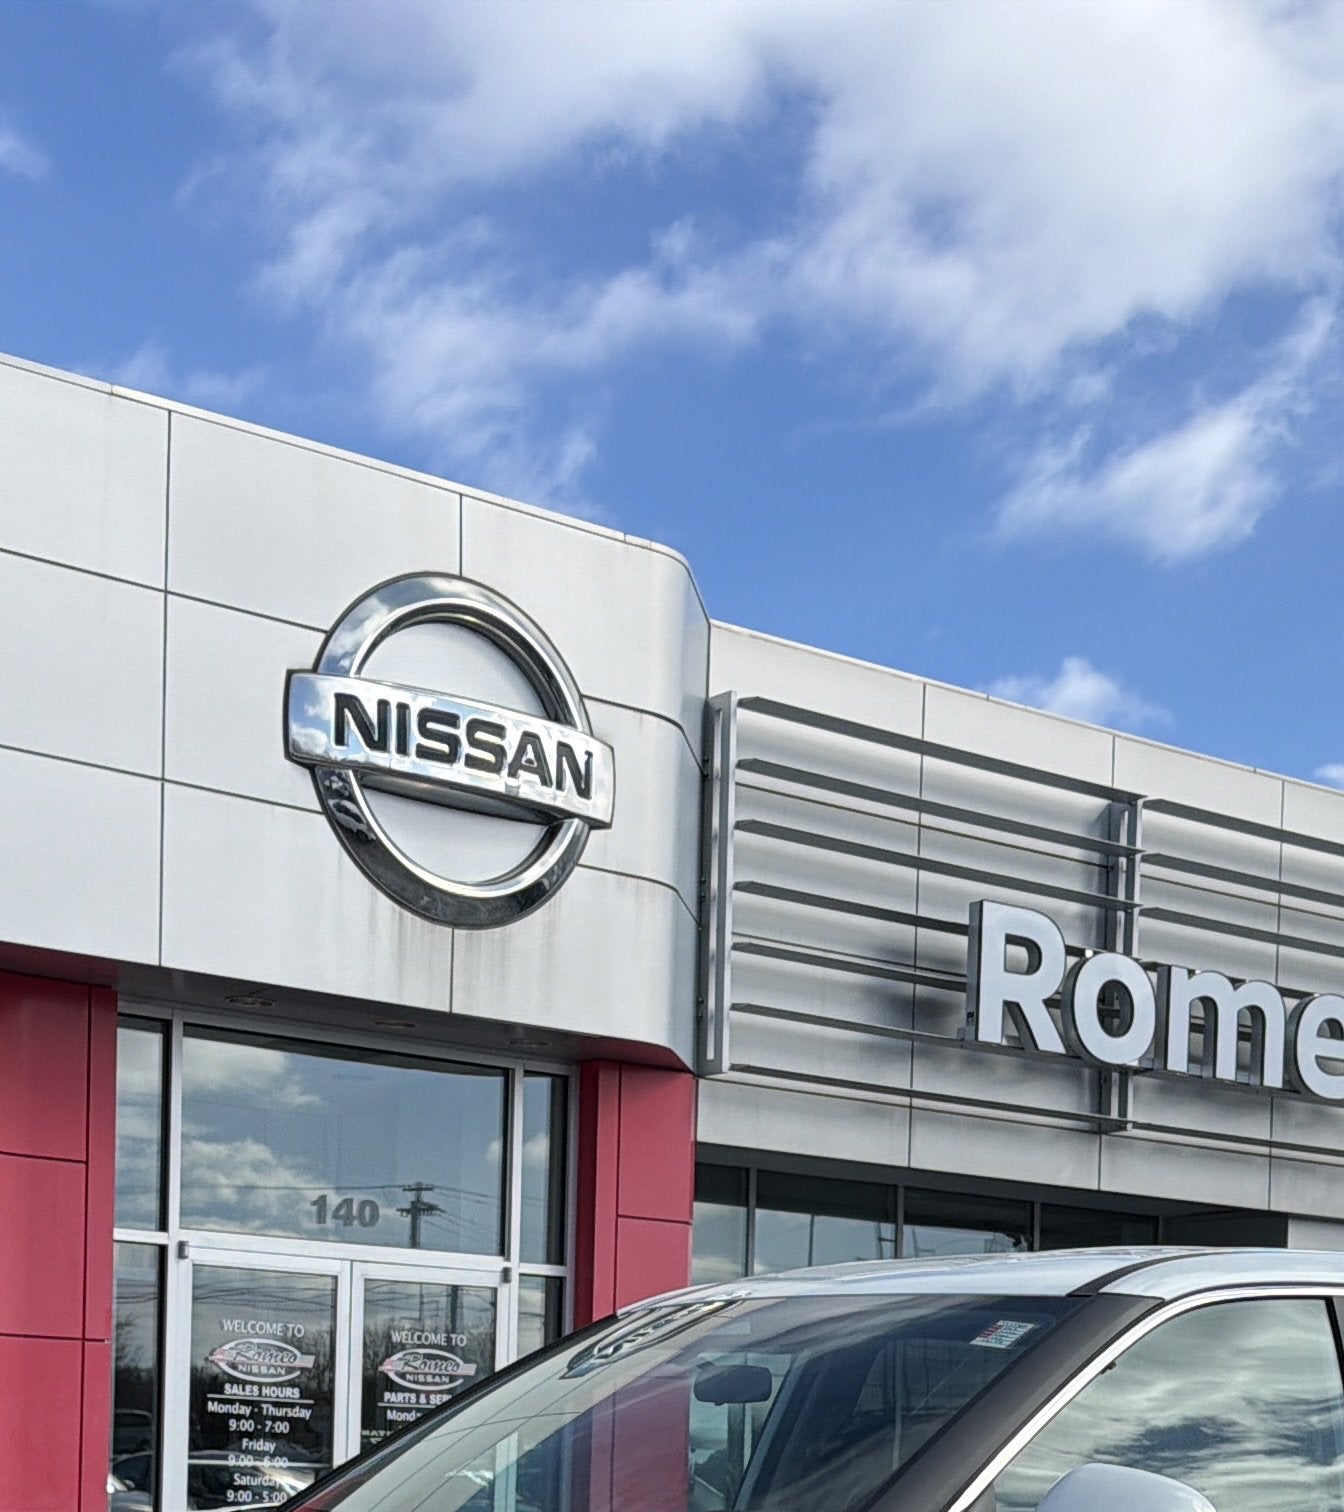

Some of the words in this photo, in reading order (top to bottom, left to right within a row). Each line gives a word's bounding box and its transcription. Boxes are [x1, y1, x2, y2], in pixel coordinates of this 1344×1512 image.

[333, 692, 594, 801] NISSAN
[310, 1194, 380, 1228] 140
[222, 1319, 284, 1337] WELCOME
[287, 1323, 305, 1338] TO
[391, 1330, 447, 1346] WELCOME
[449, 1333, 467, 1347] TO
[231, 1341, 298, 1364] Romeo
[237, 1364, 286, 1375] NISSAN
[398, 1352, 461, 1373] Romeo
[405, 1374, 450, 1384] NISSAN
[224, 1383, 259, 1396] SALES
[261, 1386, 300, 1399] HOURS
[383, 1392, 417, 1404] PARTS
[419, 1393, 427, 1404] &
[207, 1401, 252, 1417] Monday
[261, 1404, 312, 1420] Thursday
[228, 1419, 255, 1432] 9:00
[264, 1420, 290, 1433] 7:00
[242, 1438, 276, 1453] Friday
[233, 1473, 281, 1488] Saturday
[226, 1490, 253, 1502] 9:00
[262, 1490, 288, 1503] 5:00
